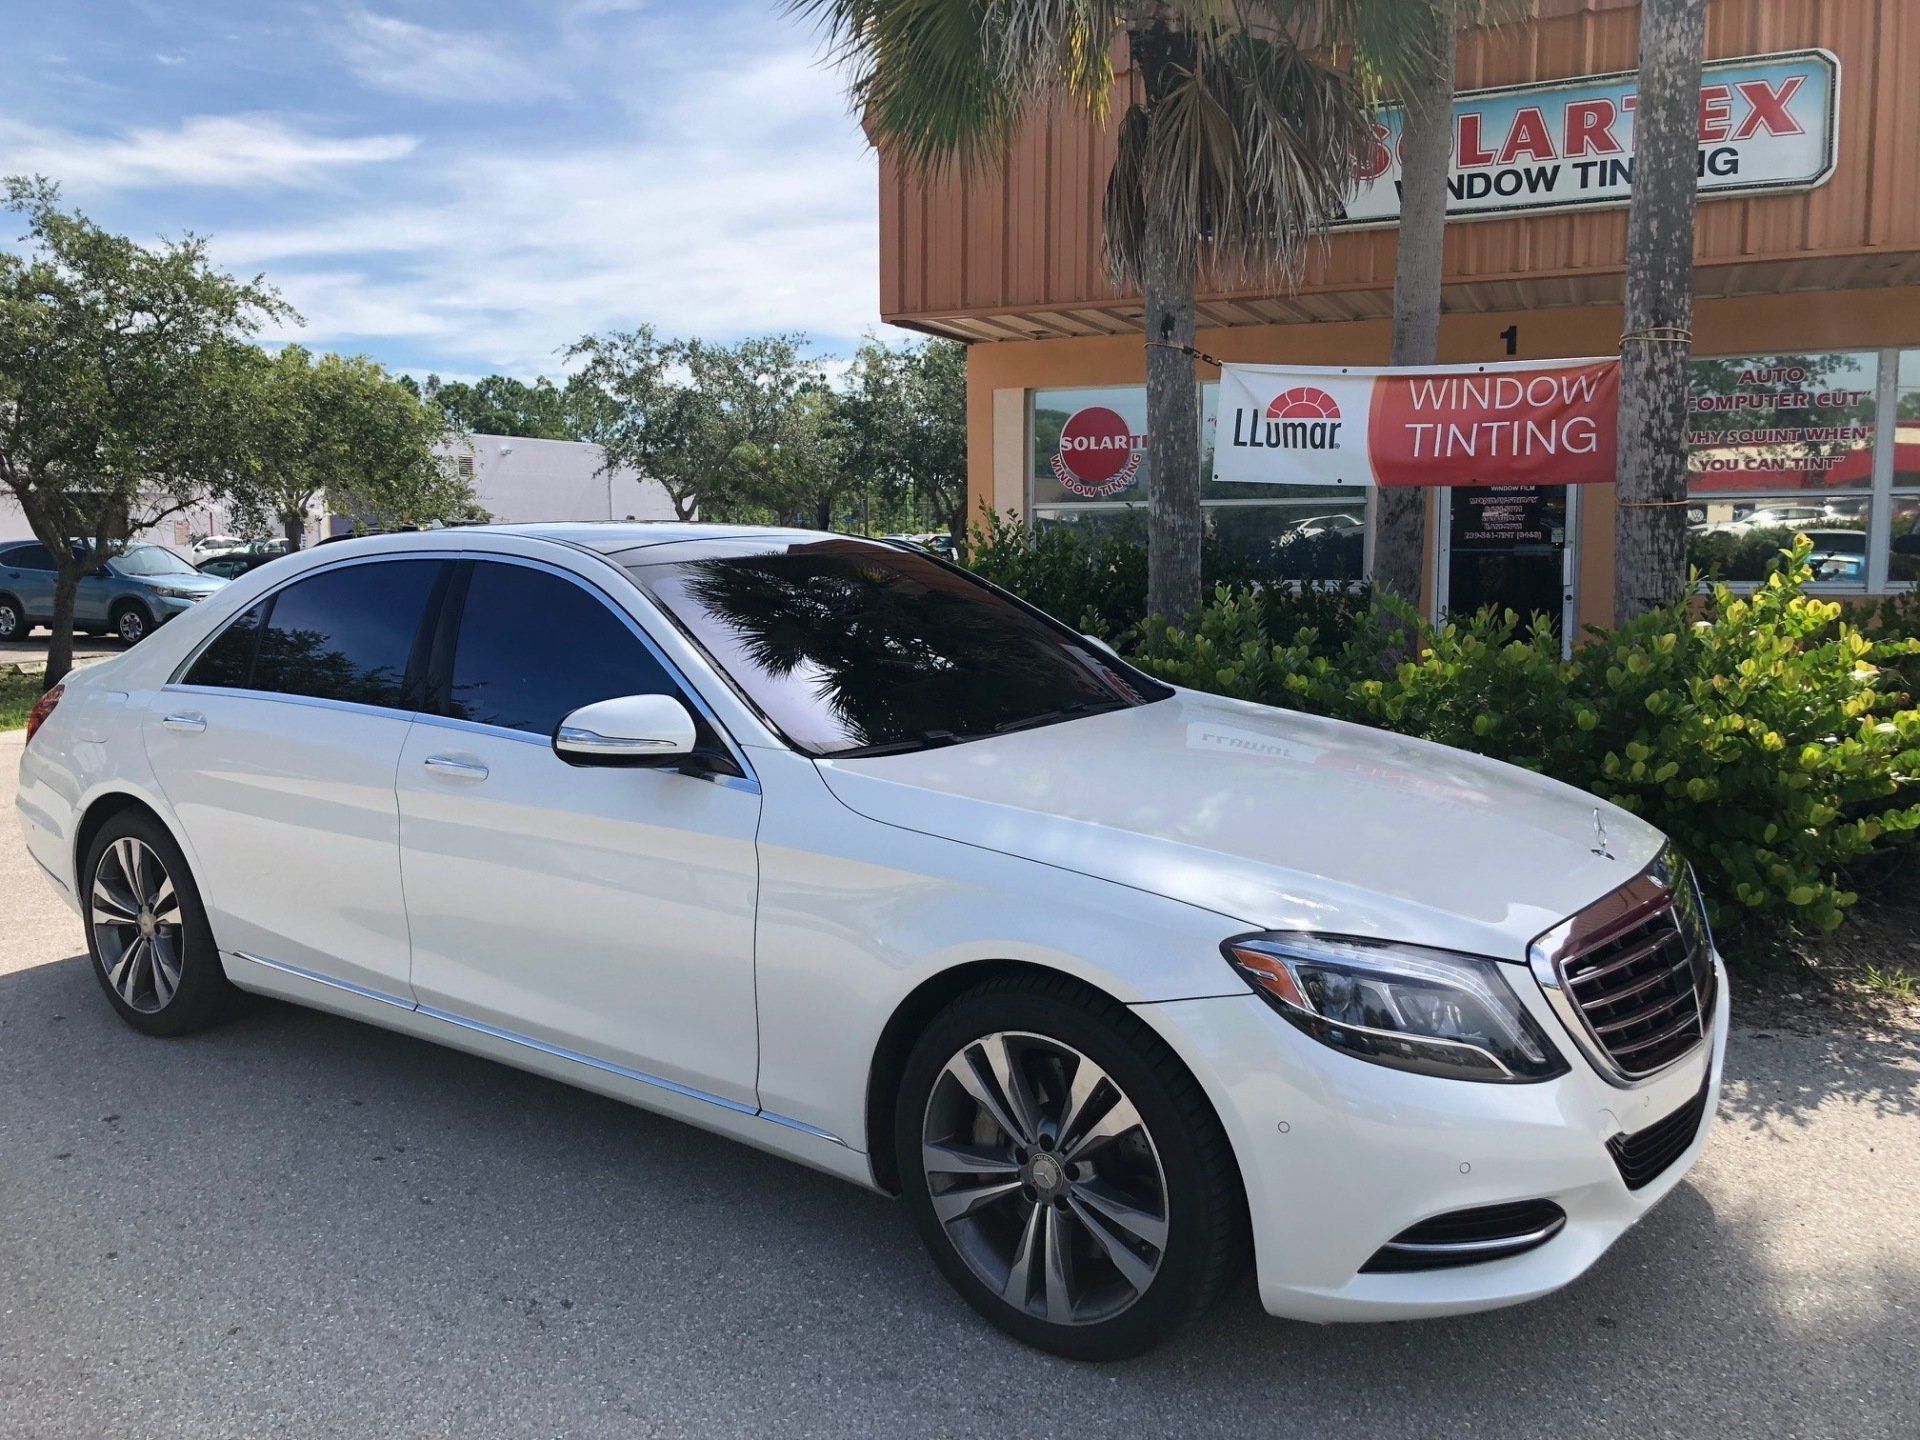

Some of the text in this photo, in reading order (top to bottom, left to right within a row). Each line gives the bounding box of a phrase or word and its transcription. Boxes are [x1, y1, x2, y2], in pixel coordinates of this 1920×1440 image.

[1349, 75, 1806, 180] SLAREX
[1394, 147, 1739, 203] NDOW TING
[1500, 325, 1517, 355] 1
[1409, 373, 1601, 411] WINDOW
[1737, 366, 1806, 385] AUTO
[1233, 408, 1341, 450] LLumar
[1405, 416, 1597, 457] TINTING
[1727, 428, 1801, 444] SQUINT
[1804, 426, 1868, 441] WHEN
[1050, 453, 1142, 498] WINDOW TINTING
[1699, 458, 1739, 472] YOU
[1743, 457, 1785, 472] CAN
